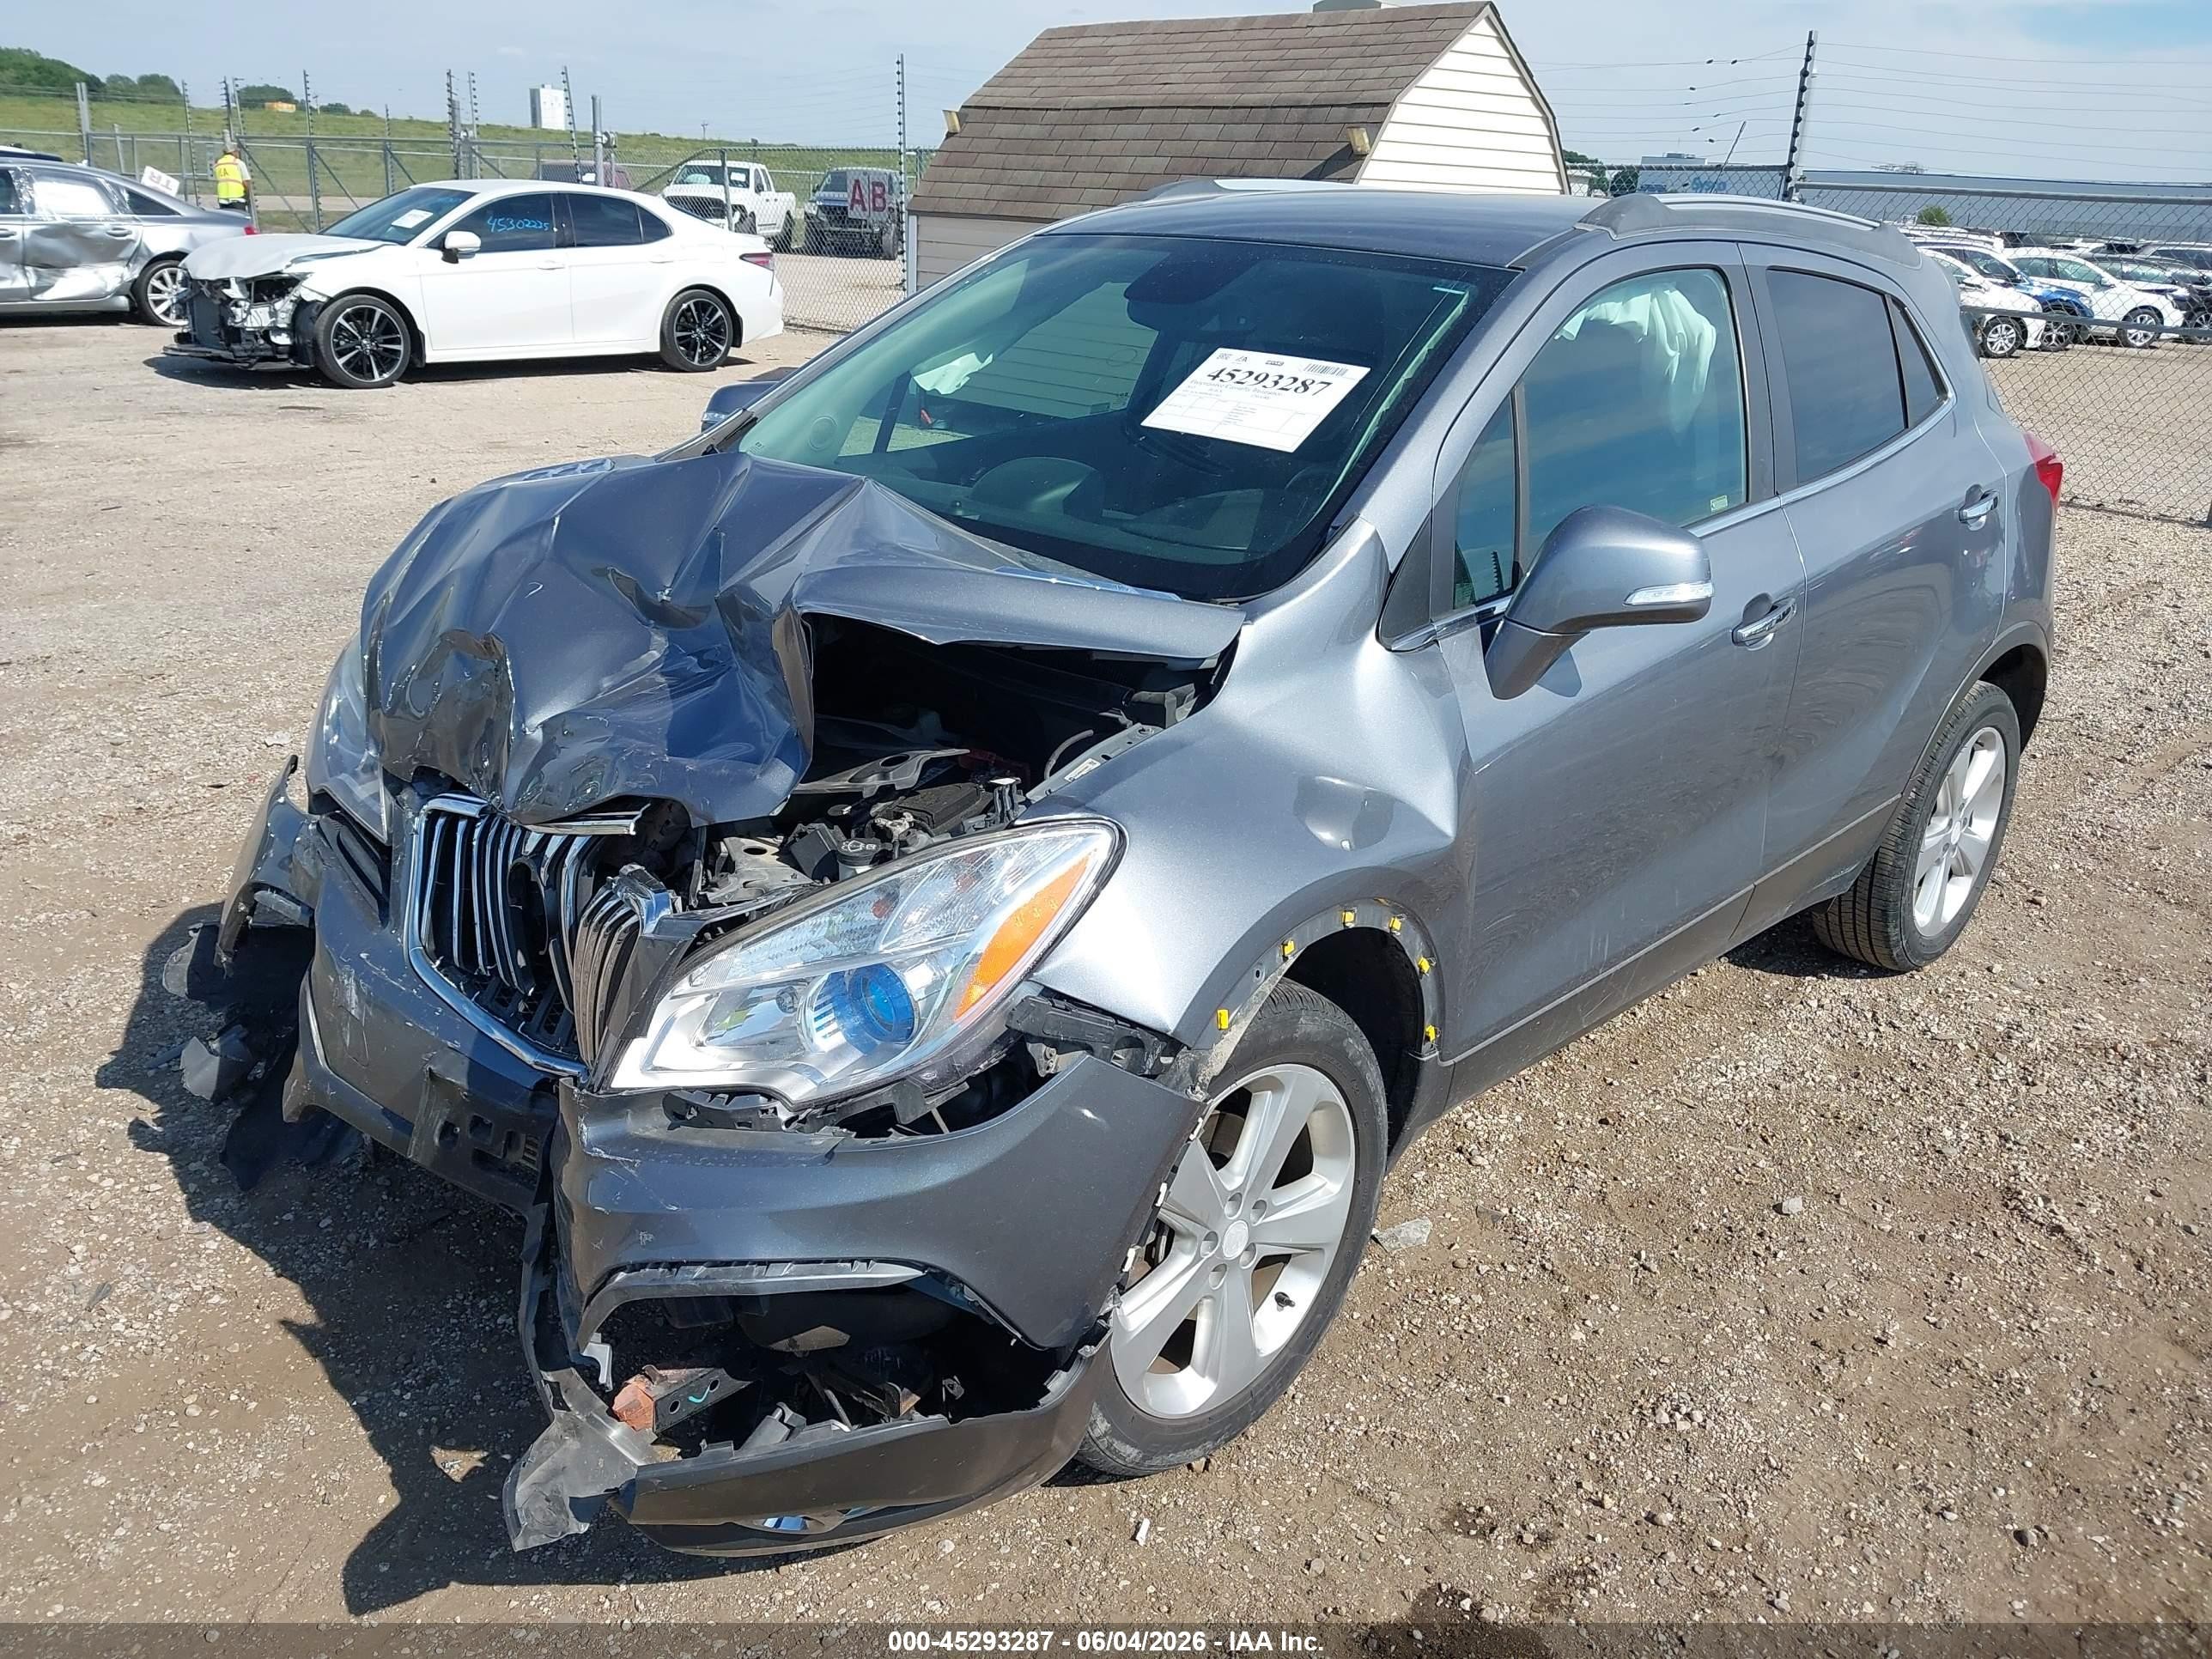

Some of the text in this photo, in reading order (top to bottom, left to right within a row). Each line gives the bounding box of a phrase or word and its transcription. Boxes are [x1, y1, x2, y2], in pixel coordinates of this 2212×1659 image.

[850, 179, 886, 212] A B
[487, 216, 550, 233] 45302225
[1207, 367, 1333, 397] 45293287
